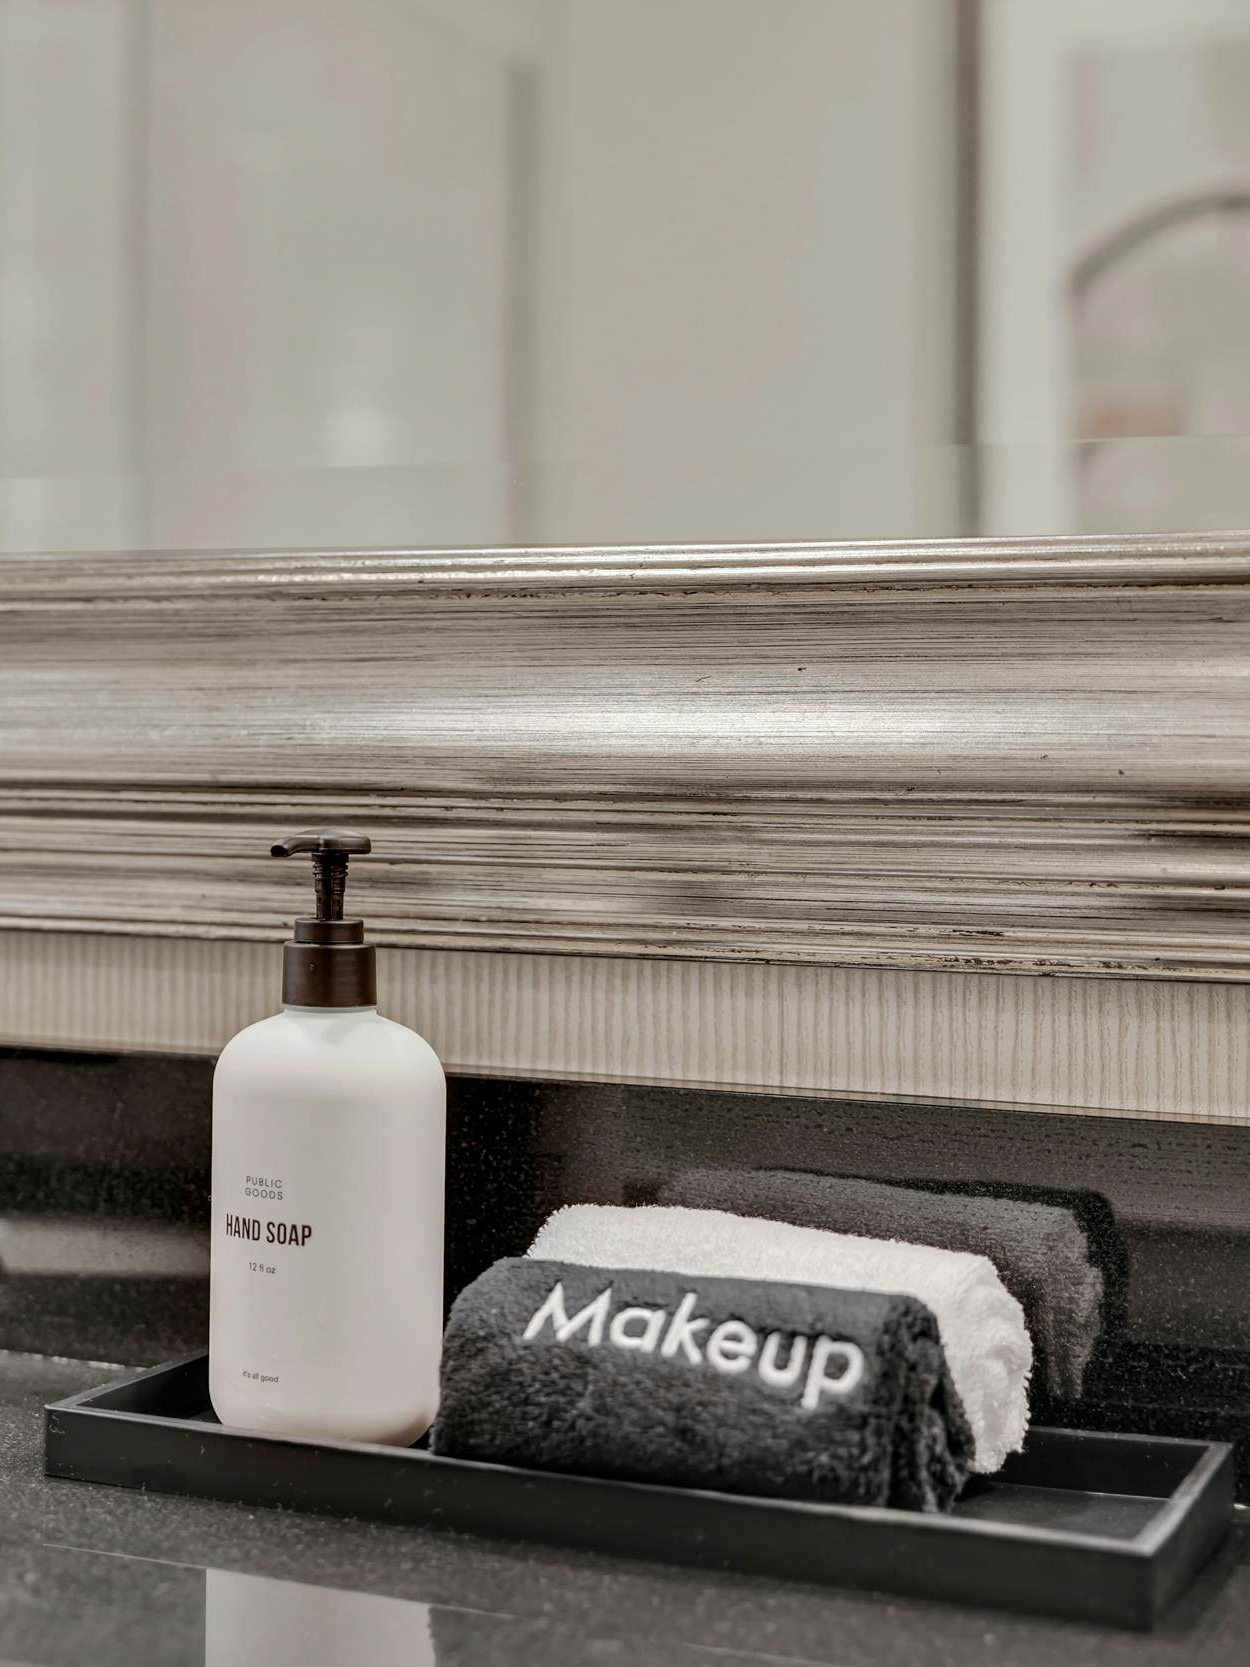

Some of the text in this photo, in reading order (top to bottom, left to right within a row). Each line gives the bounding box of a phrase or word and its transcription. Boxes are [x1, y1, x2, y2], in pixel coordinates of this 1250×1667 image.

[246, 1175, 283, 1189] PUBLIC
[245, 1187, 283, 1200] GOODS
[226, 1213, 312, 1246] HAND SOAP
[249, 1262, 257, 1272] 12
[266, 1266, 276, 1274] oz
[522, 1281, 865, 1410] Makeup
[260, 1375, 279, 1383] good
